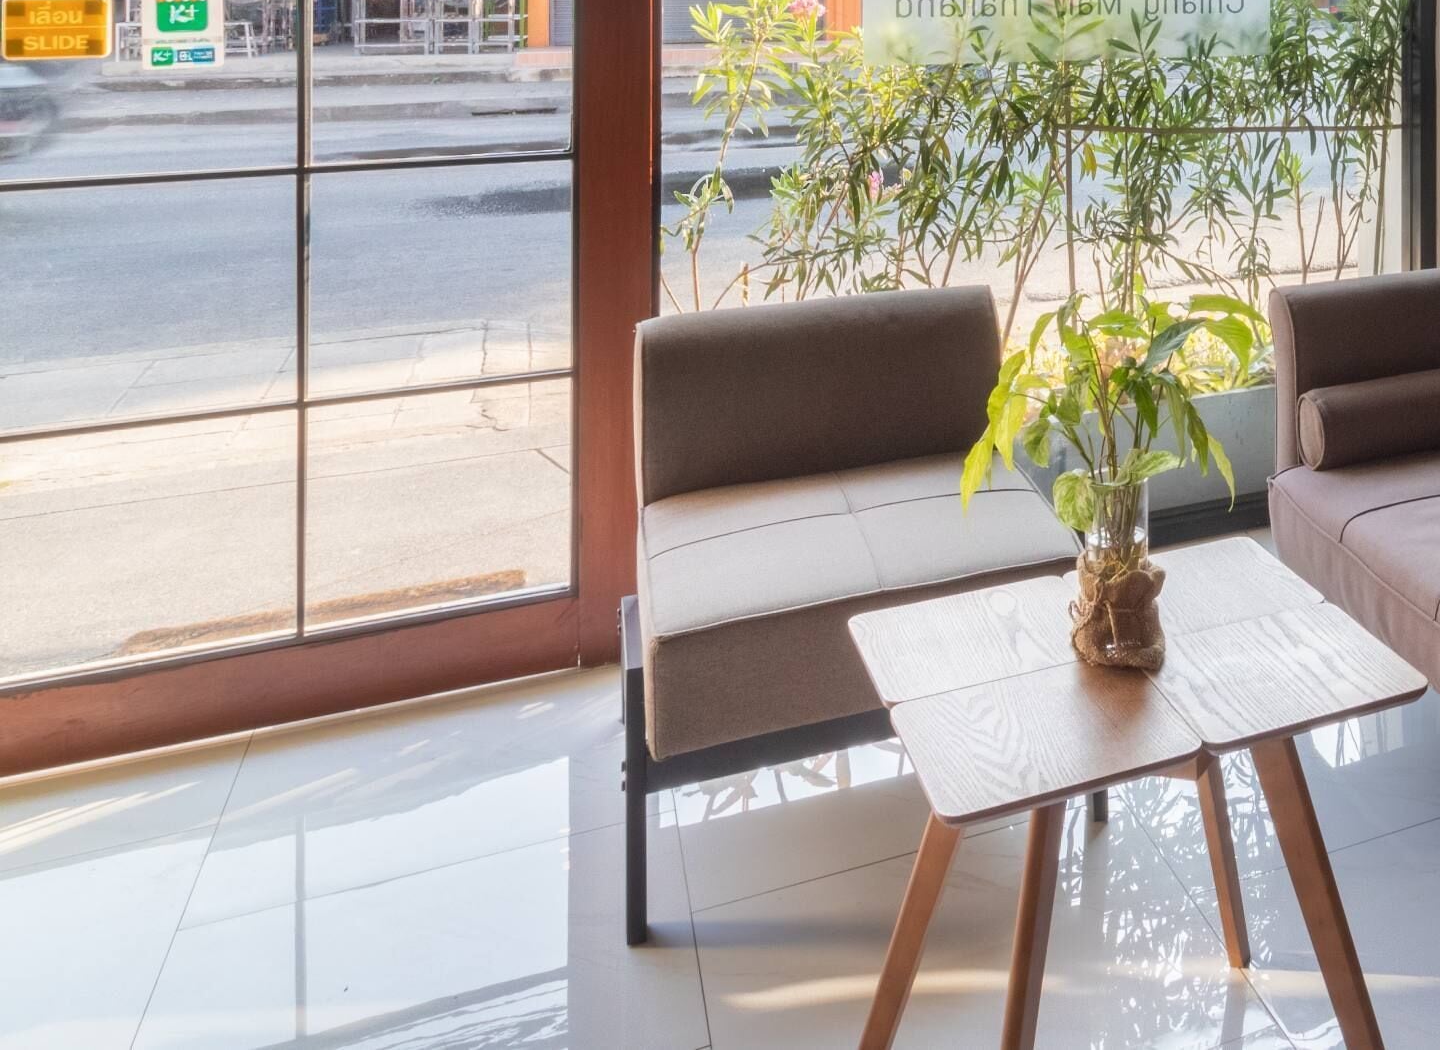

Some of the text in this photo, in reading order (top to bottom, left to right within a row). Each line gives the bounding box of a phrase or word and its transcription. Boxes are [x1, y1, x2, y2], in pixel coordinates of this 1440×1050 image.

[29, 1, 83, 25] เลื่อน
[24, 34, 90, 51] SLIDE
